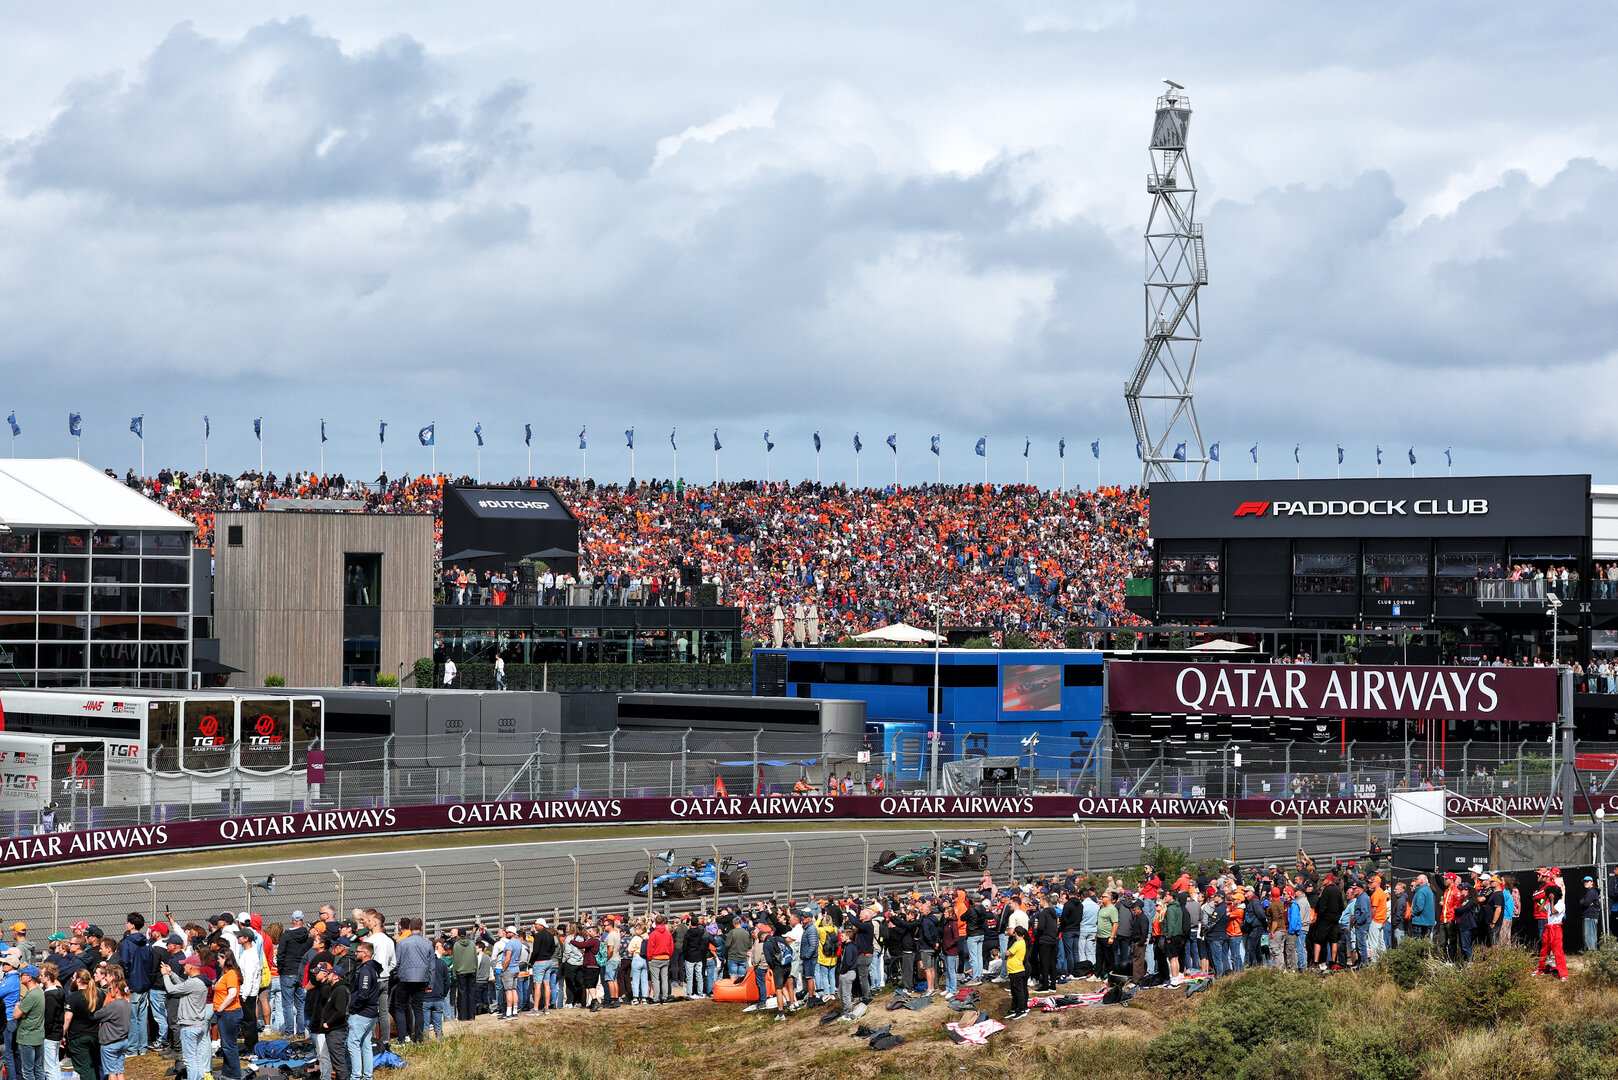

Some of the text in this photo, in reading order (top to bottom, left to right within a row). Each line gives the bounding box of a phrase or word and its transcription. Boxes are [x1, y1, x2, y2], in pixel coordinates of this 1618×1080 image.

[1273, 499, 1407, 516] PADDOCK
[1413, 499, 1489, 515] CLUB
[1176, 667, 1498, 712] QATAR AIRWAYS
[193, 737, 226, 746] TGR
[249, 736, 282, 745] TGR
[109, 744, 139, 757] TGR
[448, 800, 622, 825] QATAR AIRWAYS
[670, 797, 834, 816] QATAR AIRWAYS
[880, 797, 1034, 815] QATAR AIRWAYS
[1079, 798, 1228, 815] QATAR AIRWAYS
[1270, 799, 1331, 816] QATAR
[1447, 796, 1564, 814] QATAR AIRWAY
[219, 808, 396, 841] QATAR AIRWAYS
[0, 825, 168, 862] ATAR AIRWAYS
